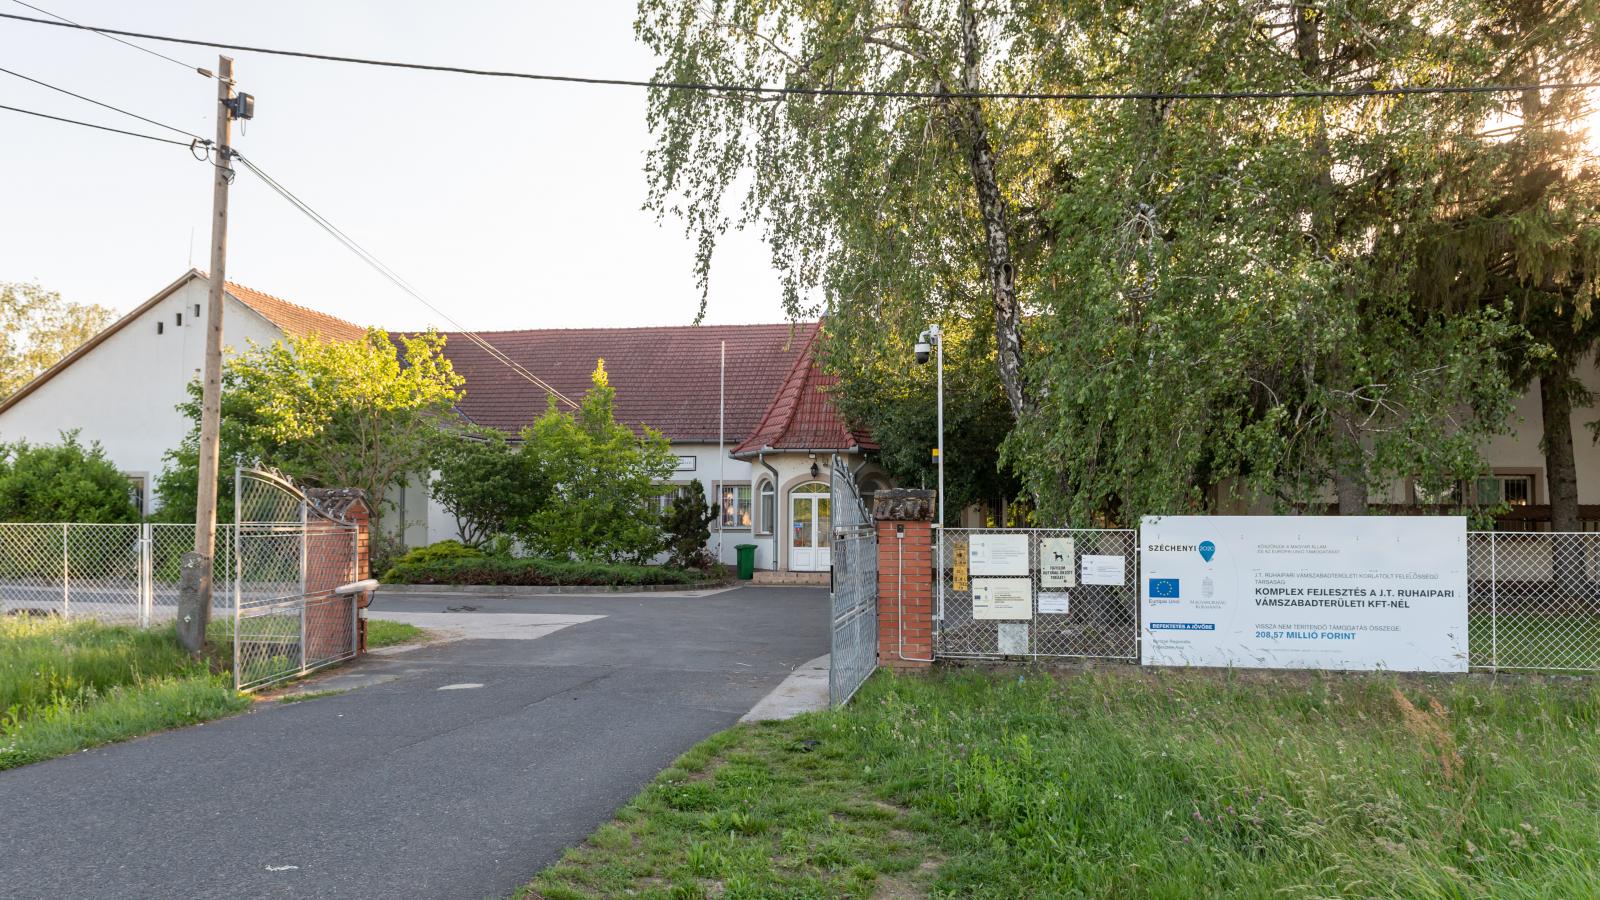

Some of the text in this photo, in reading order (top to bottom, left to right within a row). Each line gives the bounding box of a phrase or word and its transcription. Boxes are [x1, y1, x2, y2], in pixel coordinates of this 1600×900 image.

[1148, 544, 1197, 552] SZÉCHENYI
[1255, 587, 1455, 598] KOMPLEX FEJLESZTÉS A J.T. RUHAIPARI
[1255, 597, 1410, 609] VÁMSZABADTERÜLETI KFT-NÉL
[1255, 631, 1356, 640] 208,57 MILLIÓ FORINT
